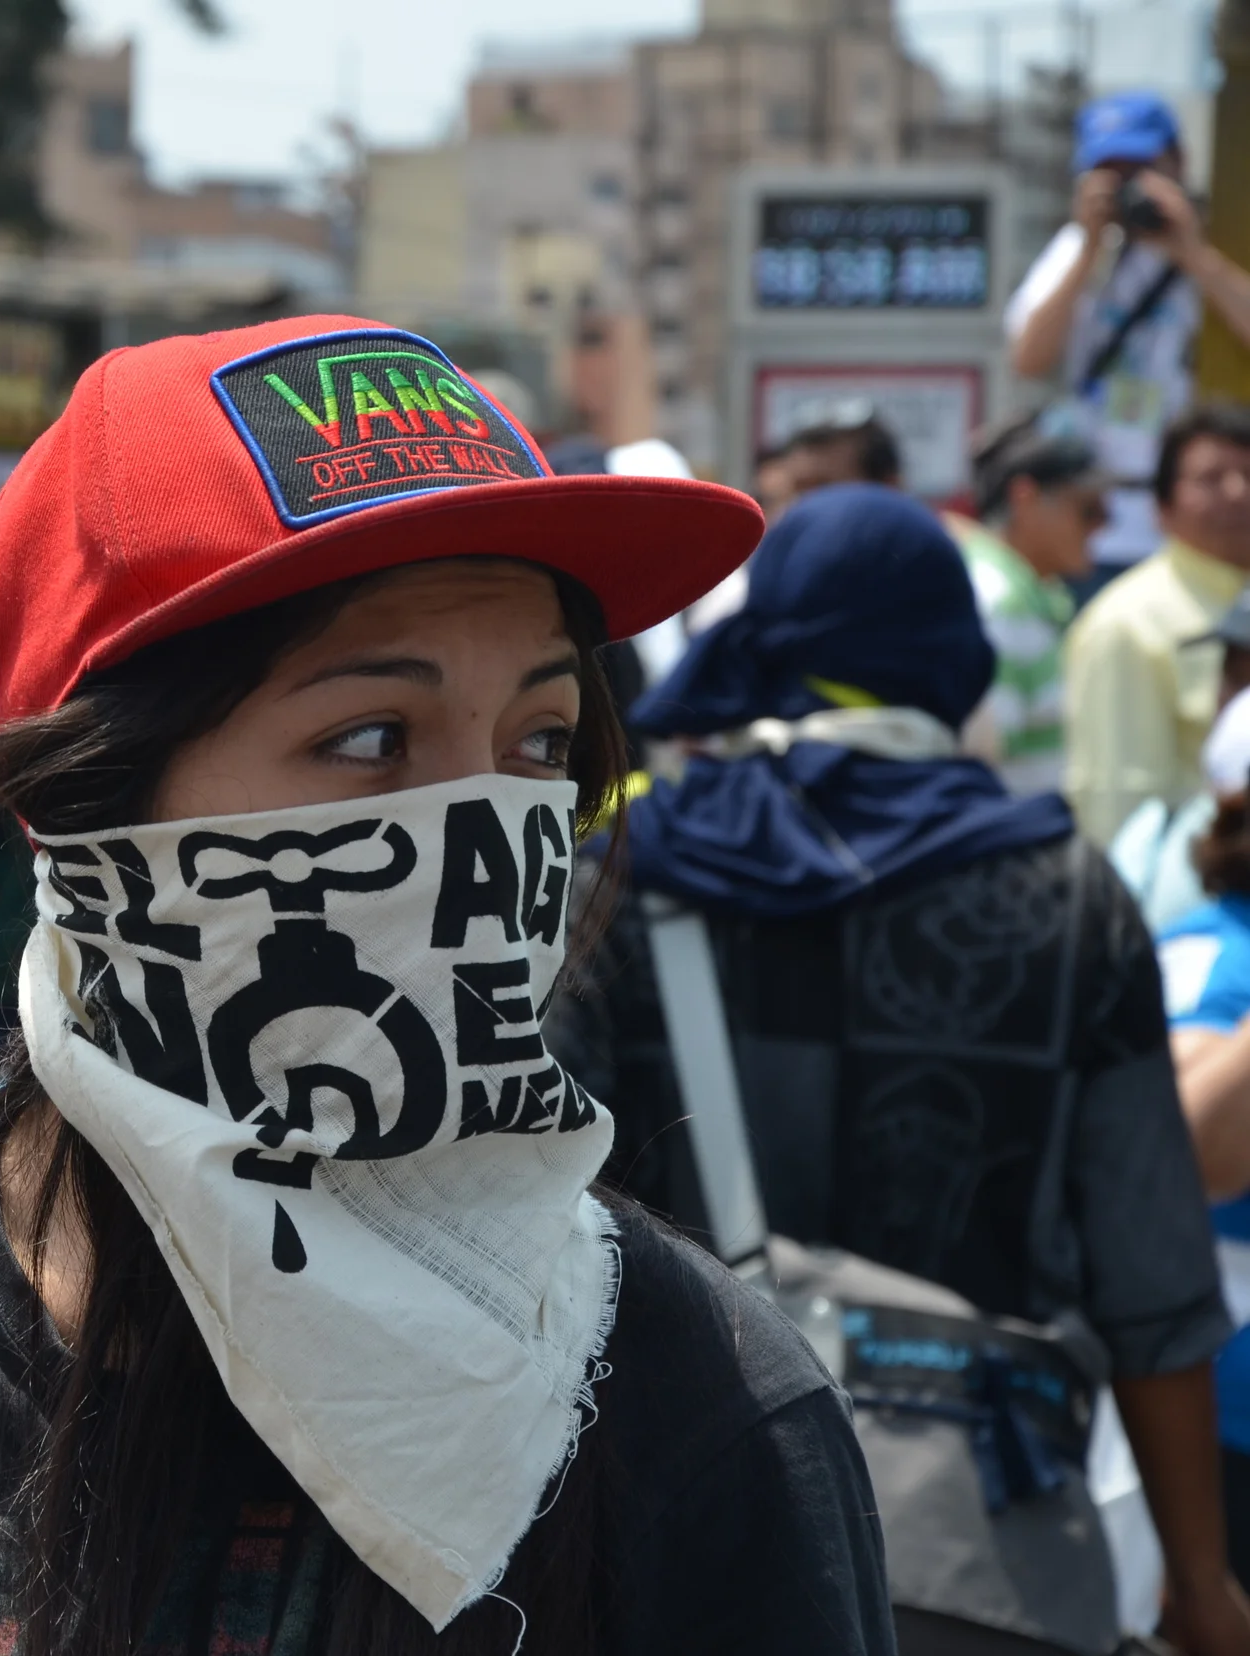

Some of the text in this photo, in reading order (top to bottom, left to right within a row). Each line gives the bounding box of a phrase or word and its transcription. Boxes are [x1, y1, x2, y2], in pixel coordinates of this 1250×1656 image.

[263, 351, 490, 449] VANS
[312, 444, 525, 489] OFF THE WALL
[48, 797, 577, 963] EL AG
